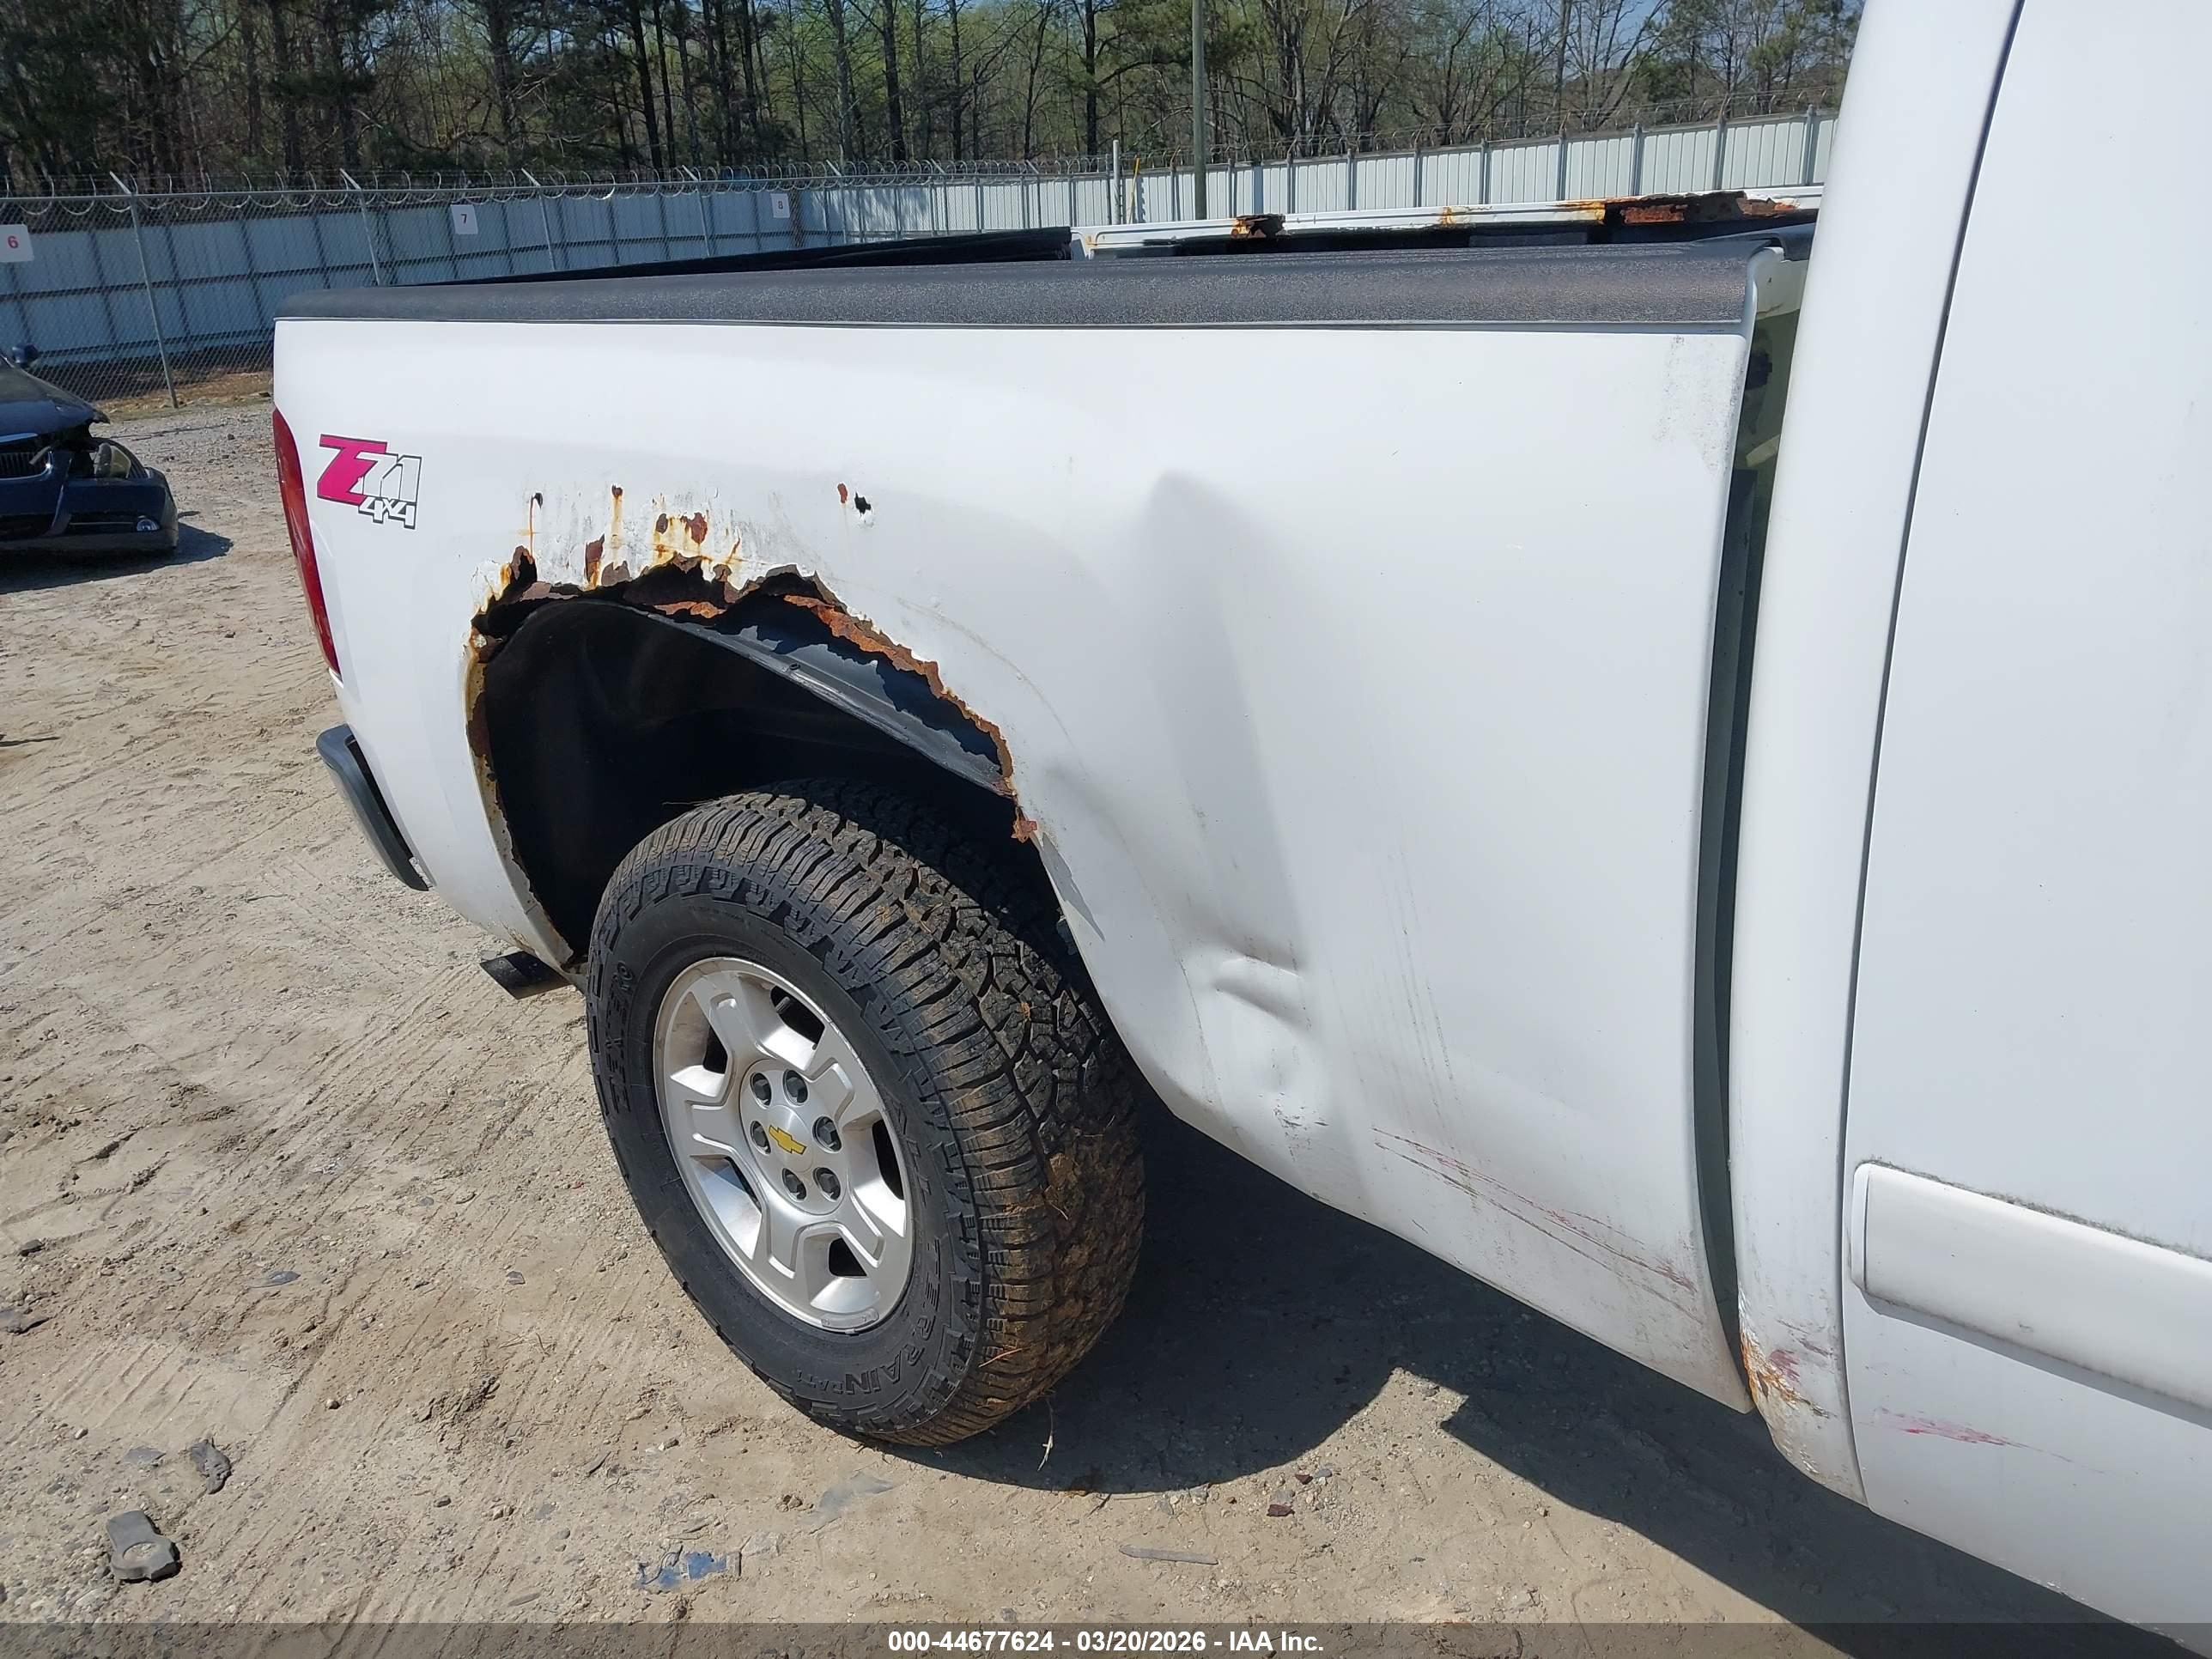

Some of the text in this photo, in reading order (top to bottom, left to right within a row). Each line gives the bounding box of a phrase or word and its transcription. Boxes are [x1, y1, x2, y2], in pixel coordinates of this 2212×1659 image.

[460, 213, 468, 224] 7
[777, 200, 784, 210] 8
[7, 234, 19, 249] 6
[317, 434, 422, 506] Z71
[892, 1097, 932, 1205] ALL
[845, 1237, 940, 1395] TERRAIN
